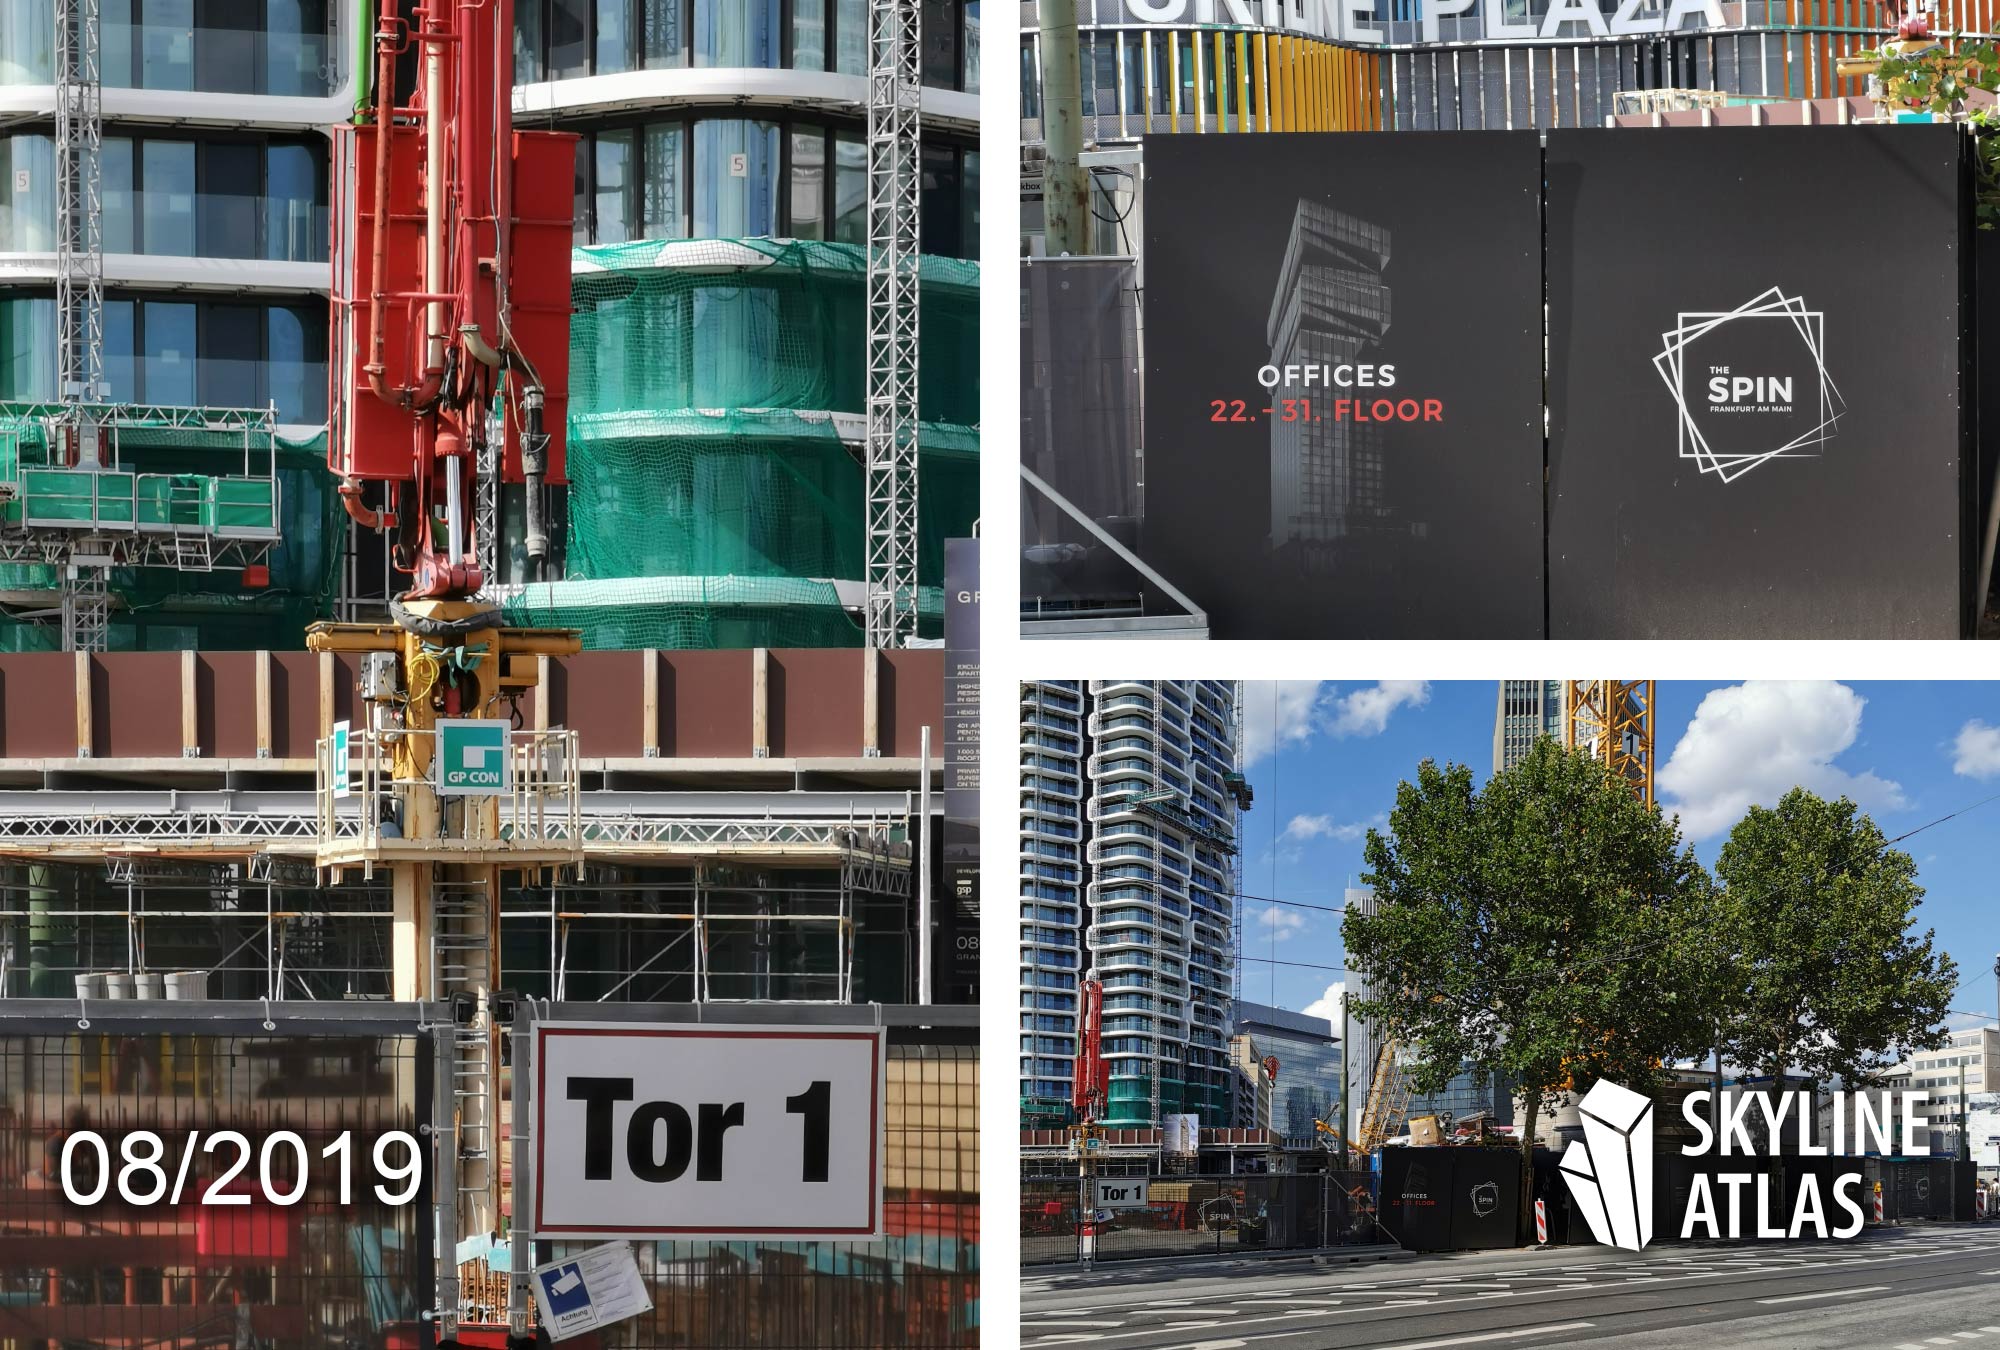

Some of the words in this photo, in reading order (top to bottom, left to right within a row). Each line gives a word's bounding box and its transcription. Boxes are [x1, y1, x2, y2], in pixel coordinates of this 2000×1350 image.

[734, 157, 744, 172] 5
[1257, 364, 1396, 387] OFFICES
[1709, 366, 1730, 375] THE
[1708, 376, 1793, 403] SPIN
[1335, 400, 1443, 422] FLOOR
[1625, 733, 1634, 758] 1
[448, 771, 465, 784] GP
[469, 771, 499, 784] CON
[566, 1076, 744, 1183] Tor
[785, 1081, 832, 1183] 1
[1101, 1185, 1128, 1201] Tor
[1134, 1185, 1142, 1200] 1
[1209, 1212, 1230, 1220] SPIN
[561, 1309, 588, 1322] Achtung
